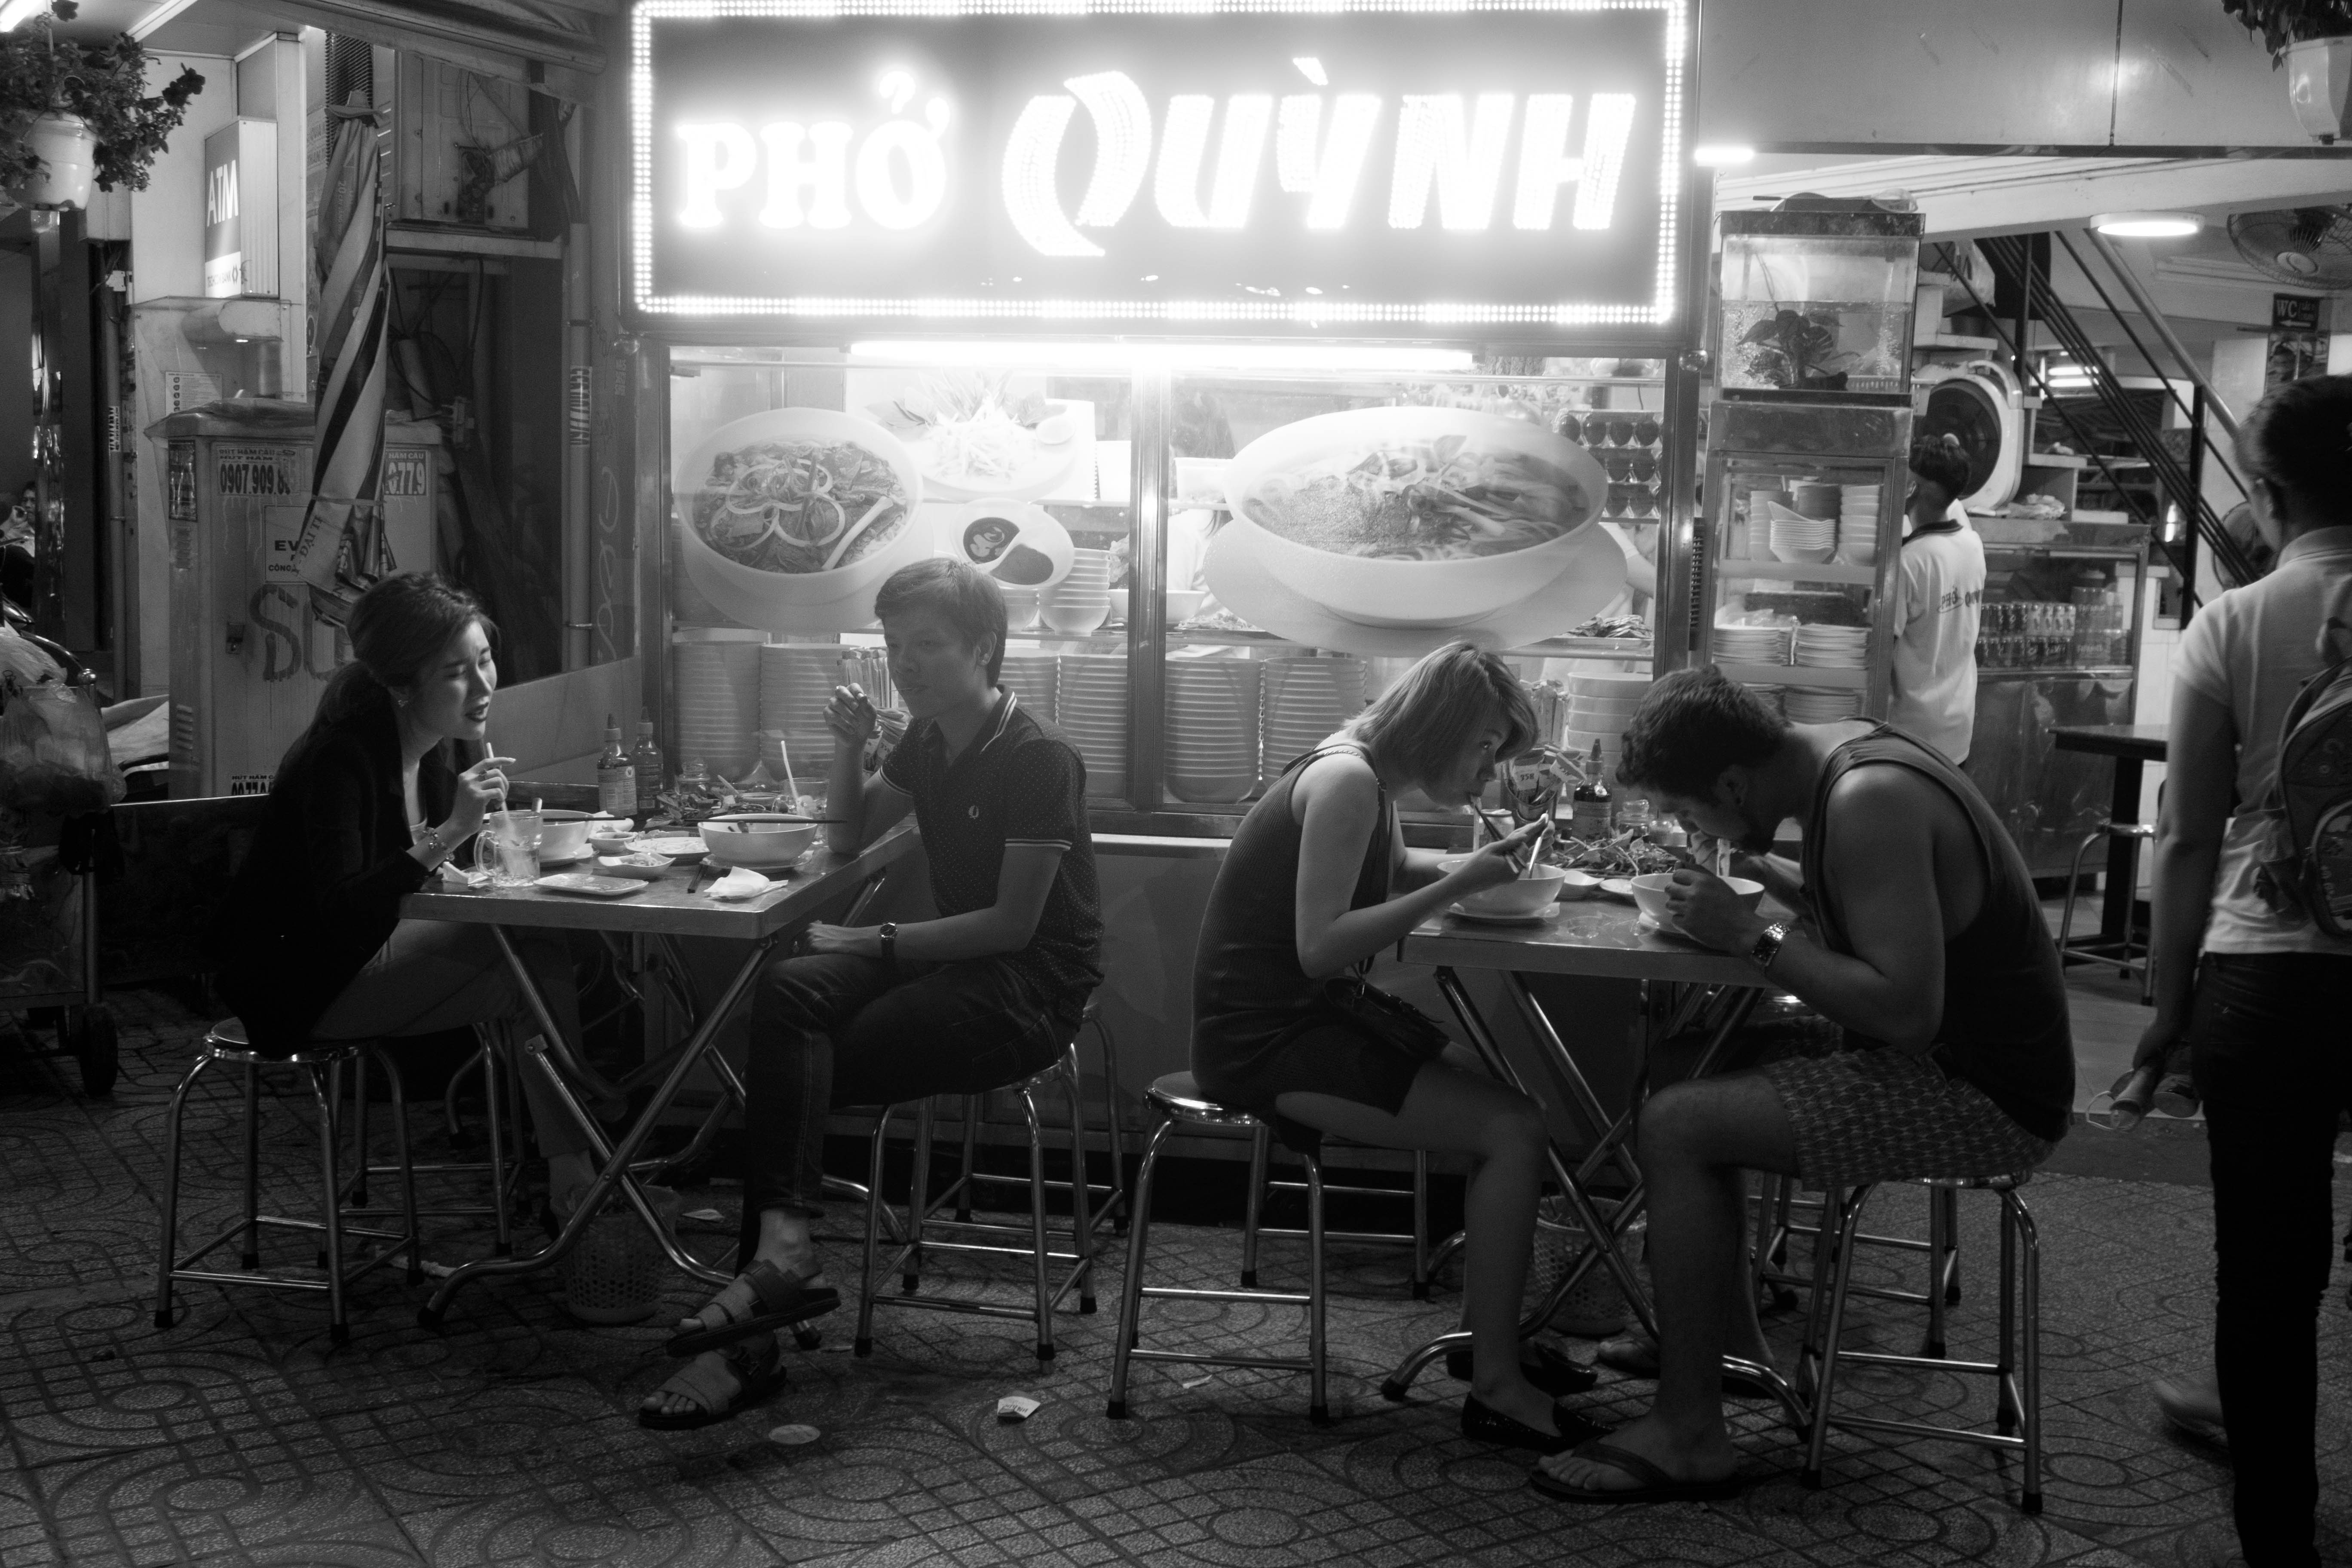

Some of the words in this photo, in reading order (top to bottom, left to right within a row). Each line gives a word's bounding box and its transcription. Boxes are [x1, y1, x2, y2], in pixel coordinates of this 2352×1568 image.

[674, 69, 952, 231] PHỞ
[1001, 57, 1637, 257] QUỲNH
[207, 159, 238, 227] ATM
[2276, 300, 2297, 318] WC
[275, 540, 299, 551] EV
